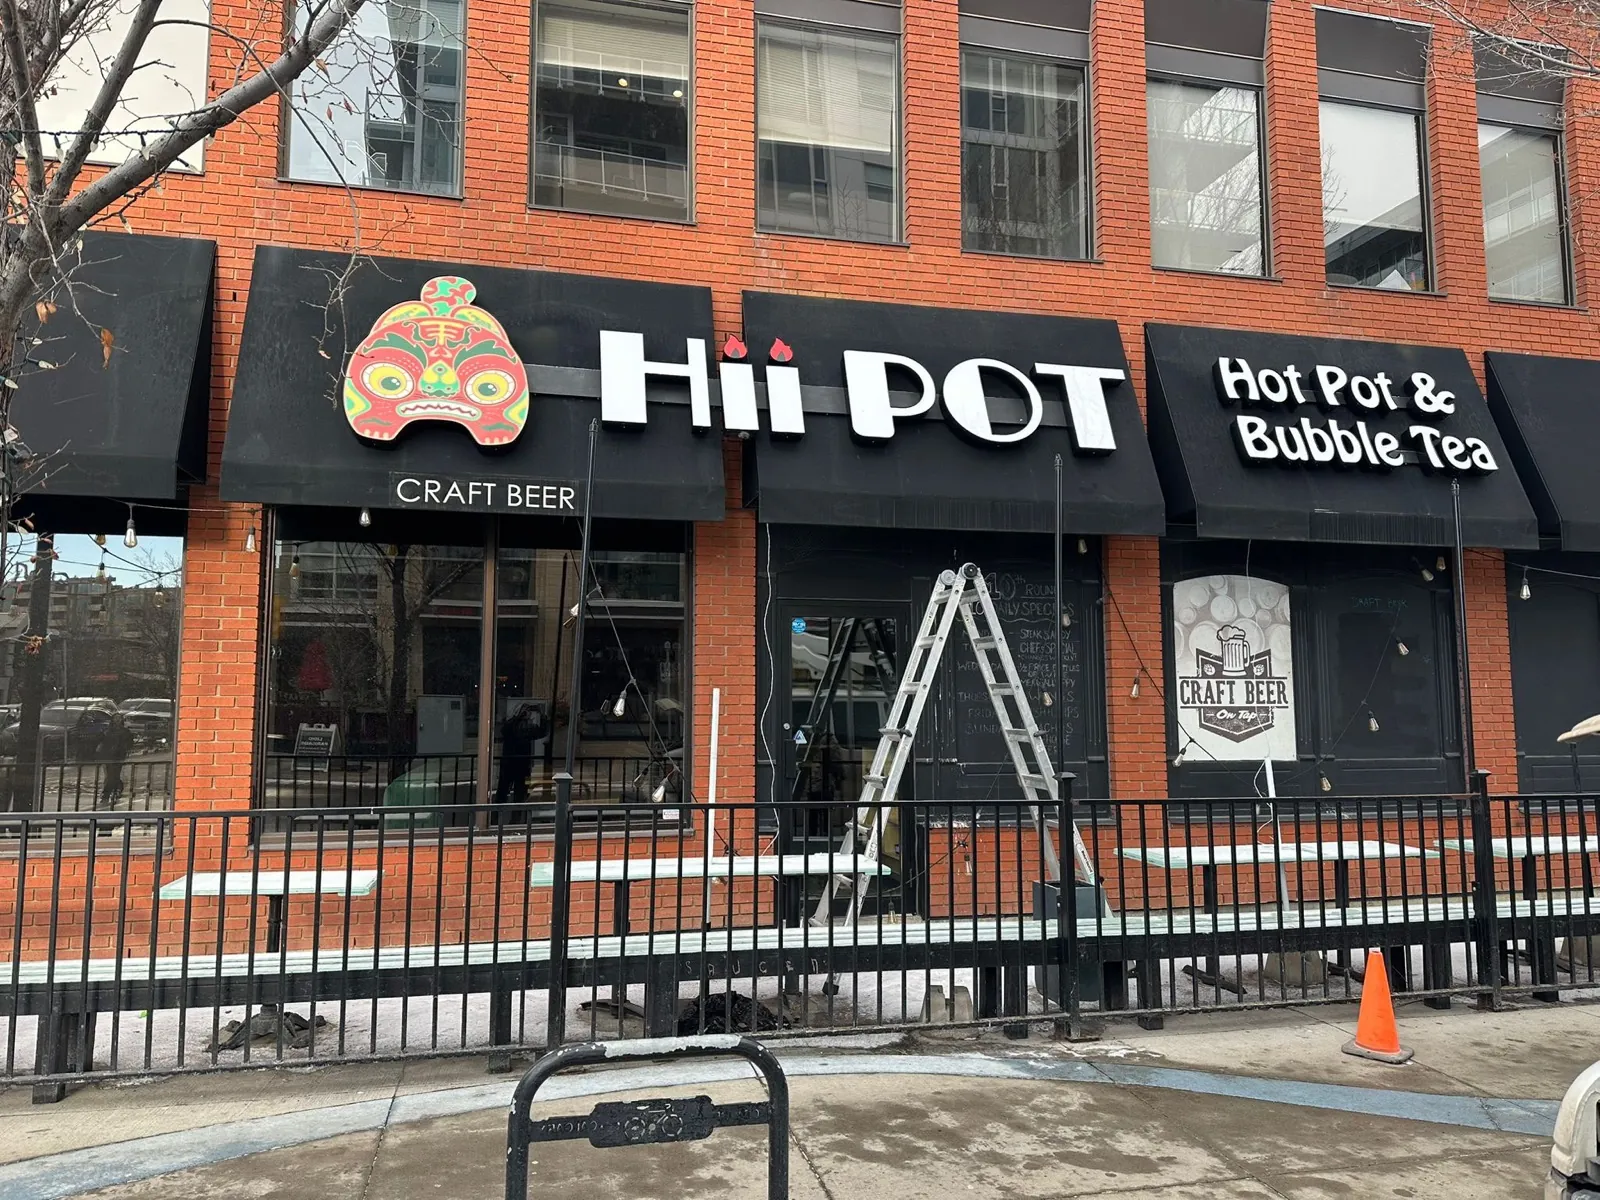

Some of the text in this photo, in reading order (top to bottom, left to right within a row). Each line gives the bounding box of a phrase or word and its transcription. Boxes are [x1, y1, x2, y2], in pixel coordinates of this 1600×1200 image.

[843, 349, 1126, 450] POT
[1217, 356, 1456, 415] Hot Pot &
[1237, 413, 1499, 472] Bubble Tea
[395, 477, 576, 511] CRAFT BEER
[1179, 680, 1289, 705] CRAFT BEER
[1216, 708, 1257, 722] On Tap
